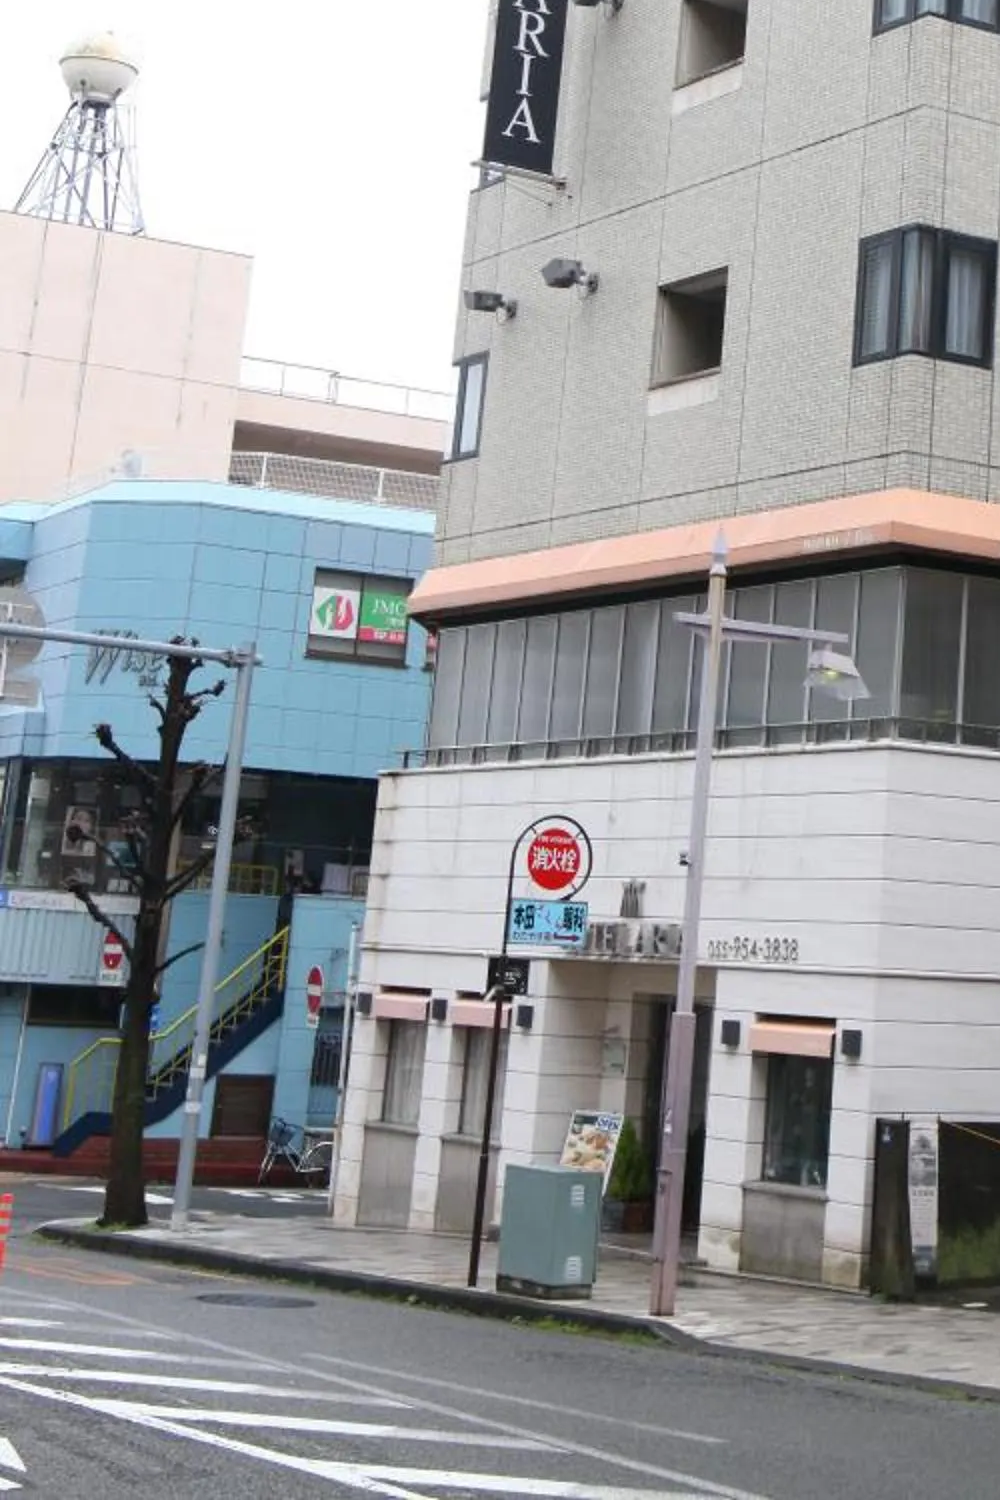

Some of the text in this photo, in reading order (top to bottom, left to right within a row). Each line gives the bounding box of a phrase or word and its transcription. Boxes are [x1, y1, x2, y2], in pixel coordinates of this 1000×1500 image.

[531, 845, 577, 872] 消火栓
[707, 935, 800, 961] 055-954-3838
